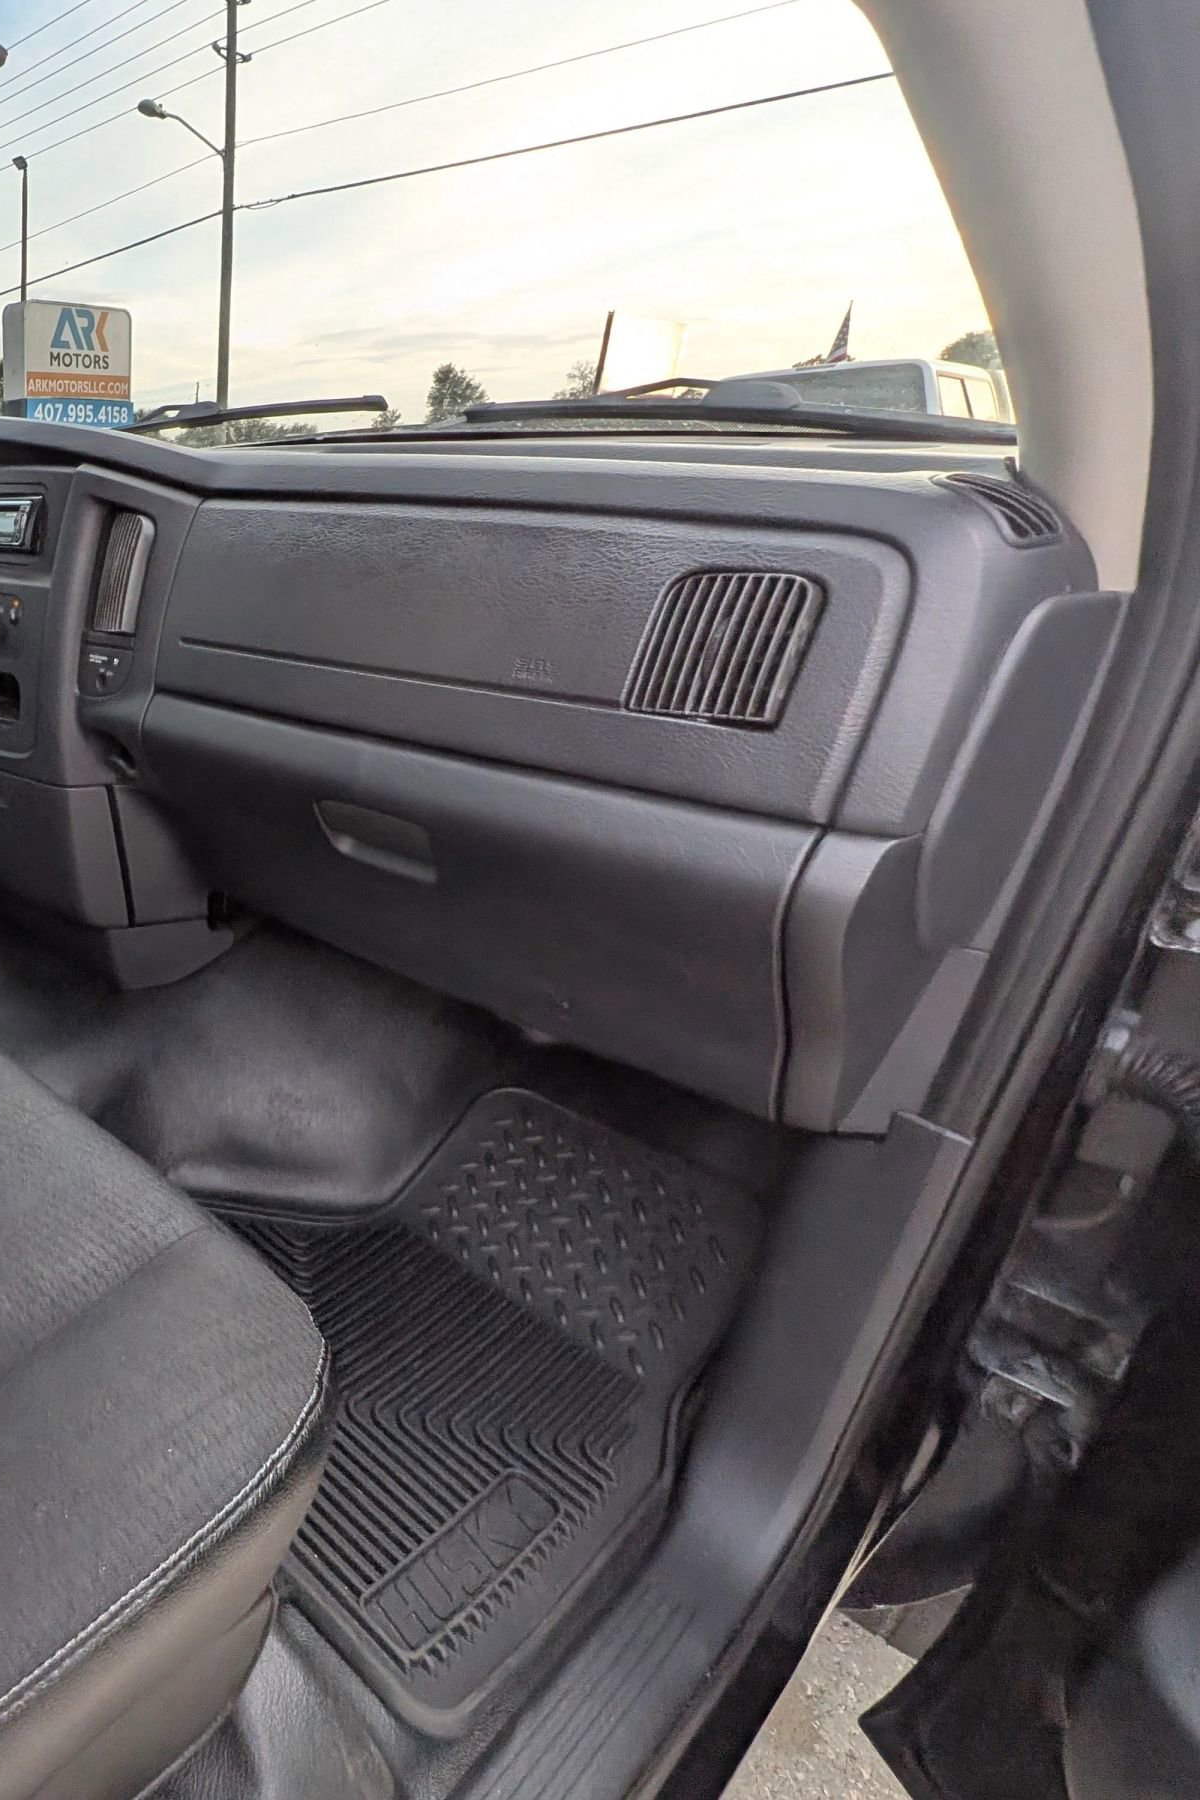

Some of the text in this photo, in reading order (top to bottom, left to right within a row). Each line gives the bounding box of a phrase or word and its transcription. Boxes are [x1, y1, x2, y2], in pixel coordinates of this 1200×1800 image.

[50, 307, 109, 352] ARK
[50, 352, 109, 370] MOTORS
[28, 378, 128, 395] ARKMOTORSLLC.COM
[34, 403, 128, 423] 407.995.4158
